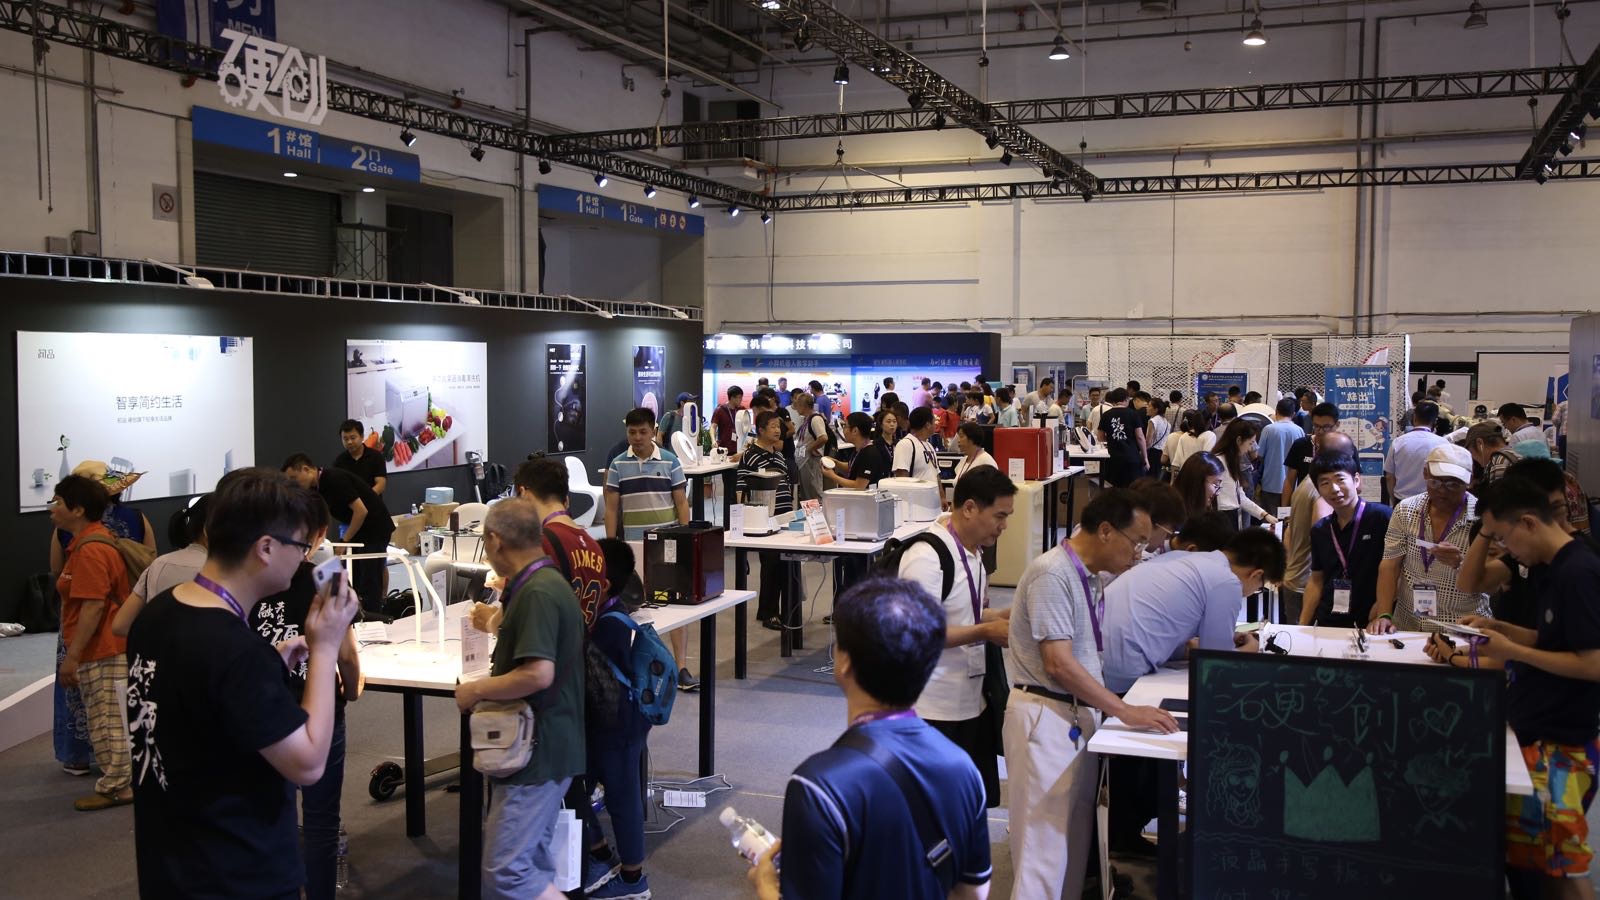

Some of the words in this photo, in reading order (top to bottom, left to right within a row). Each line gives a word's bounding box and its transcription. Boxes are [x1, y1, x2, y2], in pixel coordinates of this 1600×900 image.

[267, 128, 281, 154] 1
[286, 145, 311, 160] Hall
[351, 146, 367, 171] 2
[368, 150, 381, 162] 门
[368, 162, 394, 176] Gate
[576, 193, 584, 213] 1
[585, 206, 599, 216] Hall
[620, 203, 628, 222] 1
[629, 215, 644, 224] Gate
[116, 394, 183, 410] 智享简约生活
